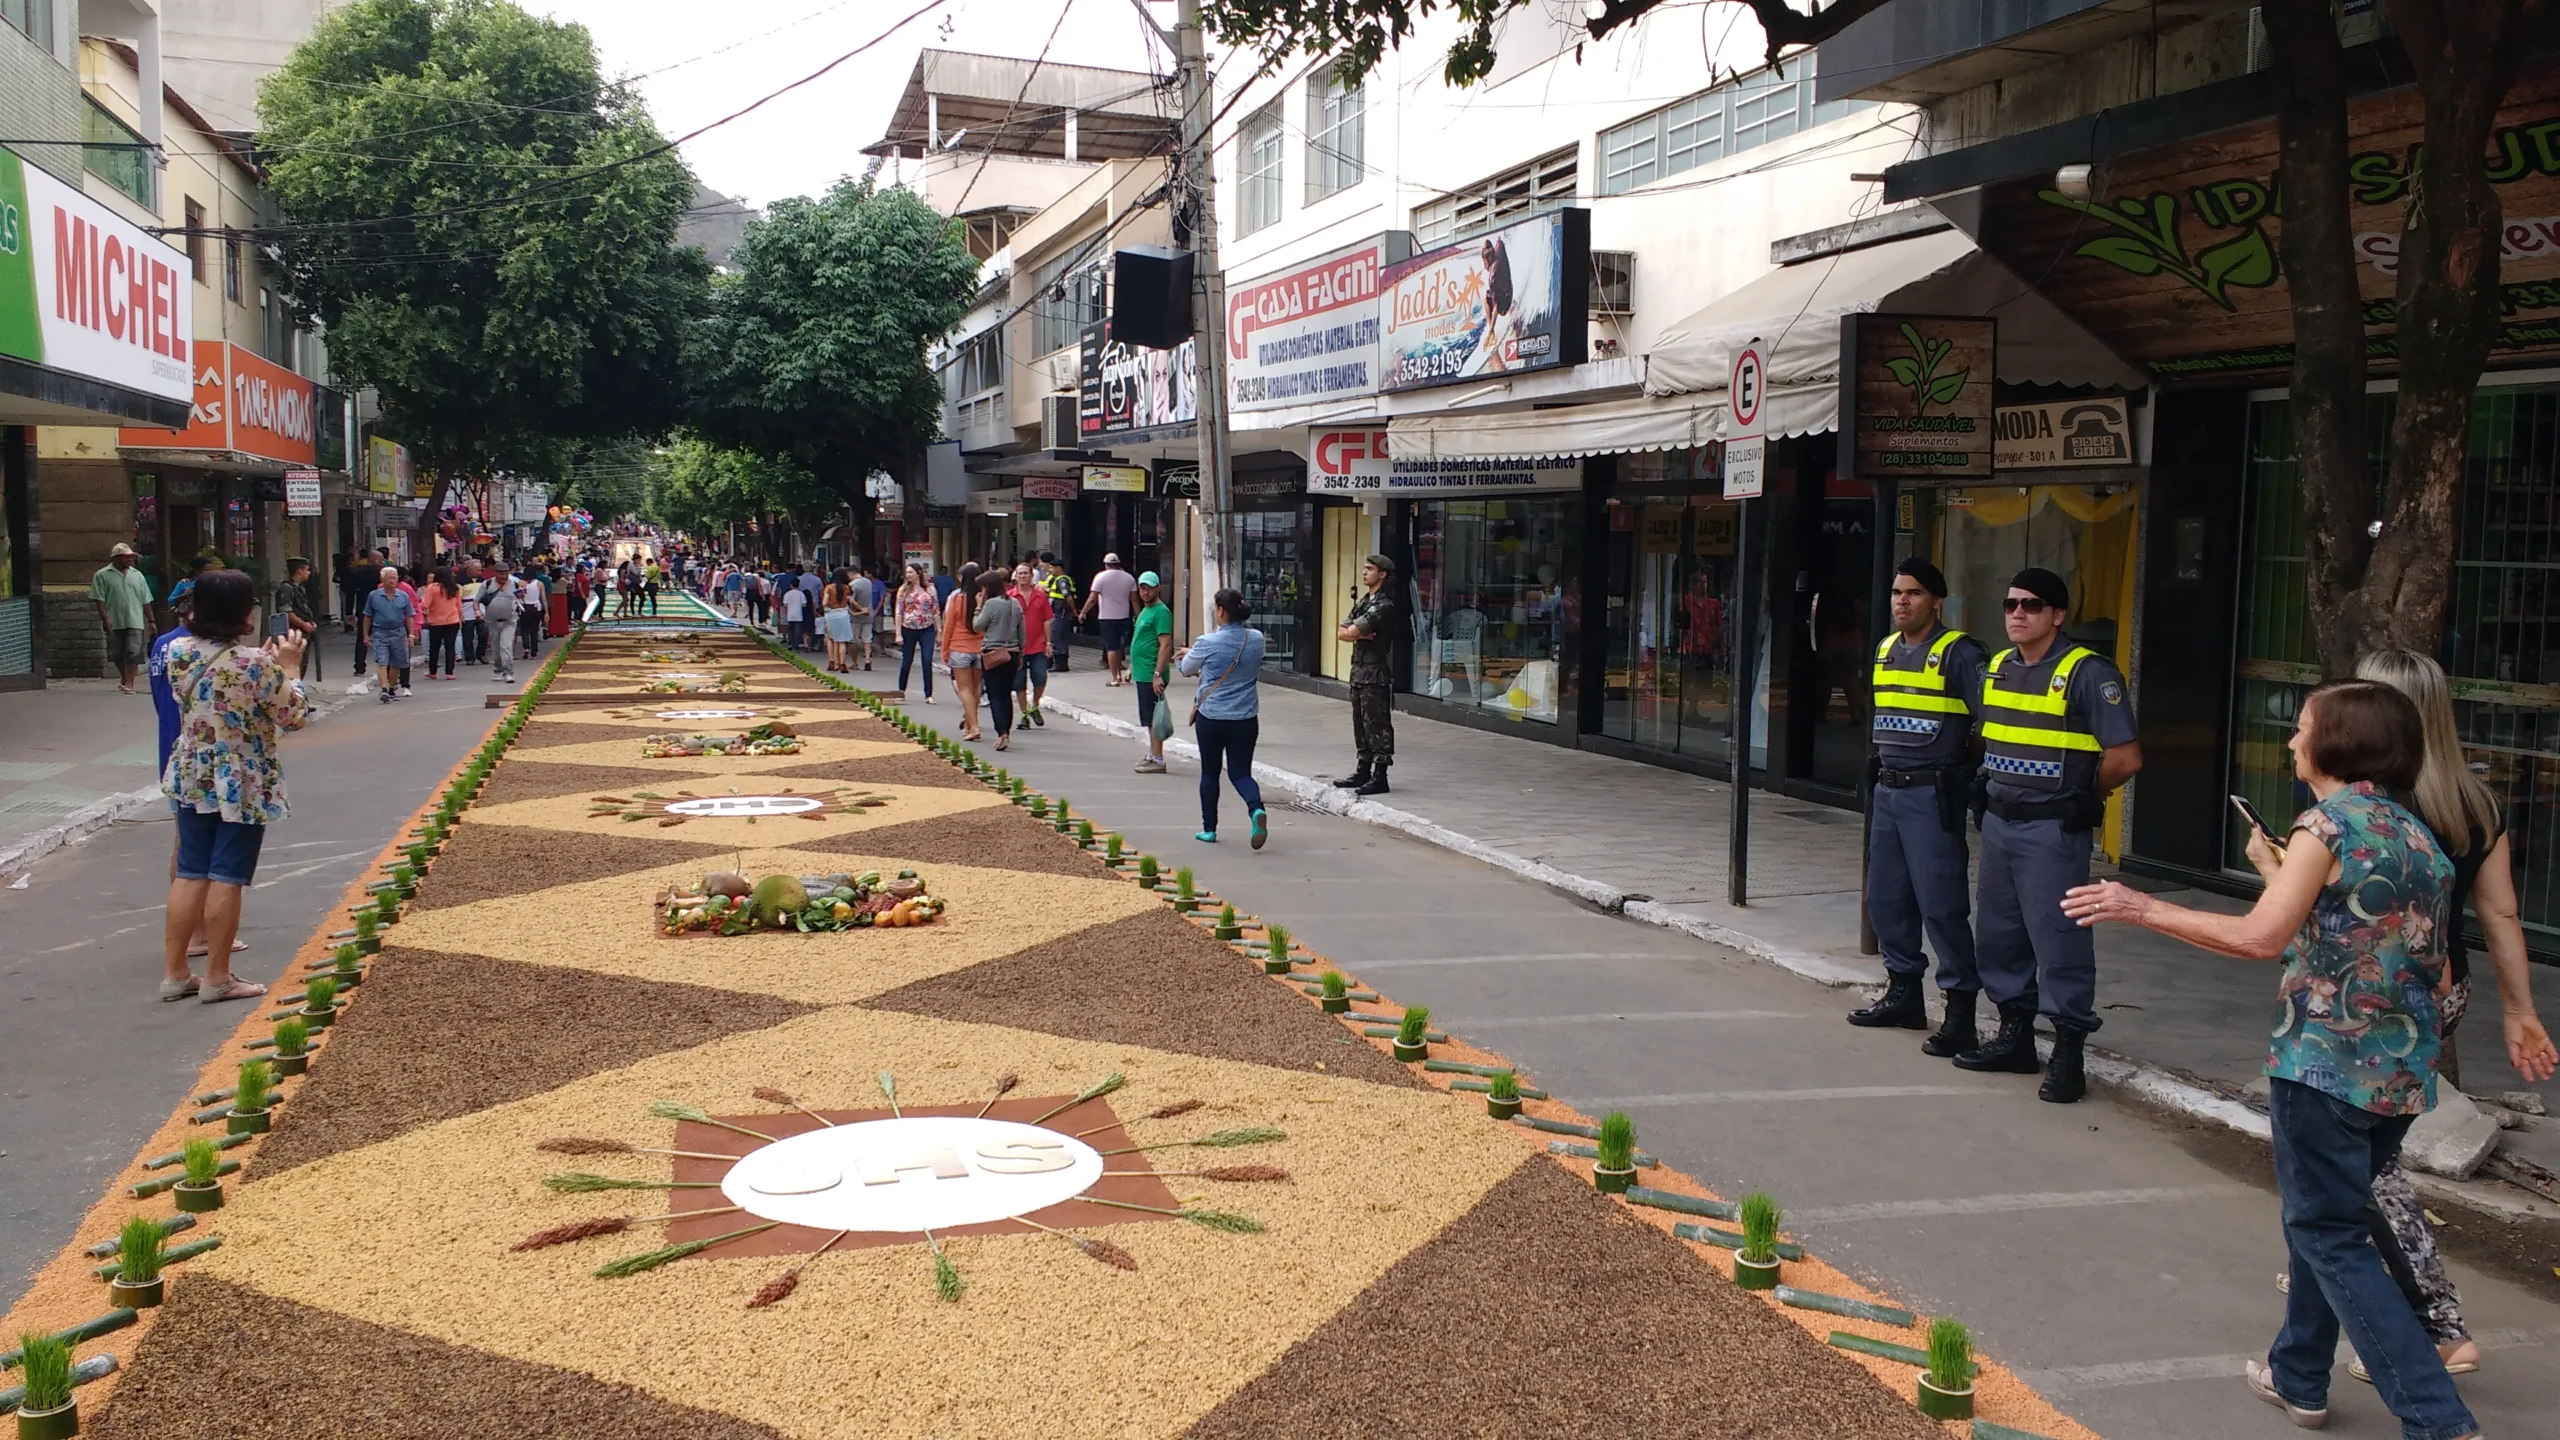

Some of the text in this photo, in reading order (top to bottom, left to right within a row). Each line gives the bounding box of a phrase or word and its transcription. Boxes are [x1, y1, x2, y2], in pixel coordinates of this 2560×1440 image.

[54, 204, 187, 363] MICHEL
[1257, 281, 1303, 324] CASA
[1387, 267, 1458, 335] Jadd's
[1424, 320, 1456, 340] modas
[1259, 337, 1288, 368] UTILIDADES
[1289, 325, 1323, 362] DOMÉSTICAS
[1325, 323, 1354, 354] MATERIAL
[1400, 349, 1464, 383] 3542-2193
[2147, 358, 2219, 372] Produtos
[1236, 376, 1266, 404] 3542-2349
[1267, 371, 1298, 400] HIDRAULICO
[1299, 368, 1318, 395] TINTAS
[1742, 365, 1754, 409] E
[1873, 418, 1904, 432] VIDA
[1889, 434, 1960, 448] Suplementos
[2072, 436, 2115, 447] 3542
[1316, 433, 1366, 474] CF
[1727, 447, 1763, 464] EXCLUSIVO
[1880, 453, 1969, 468] (28) 3310-4988
[2048, 450, 2056, 461] A
[1393, 462, 1438, 473] UTILIDADES
[1493, 460, 1533, 472] MATERIAL
[1388, 476, 1437, 488] HIDRAULICO
[1439, 476, 1467, 487] TINTAS
[1469, 476, 1474, 486] E
[1475, 473, 1537, 486] FERRAMENTAS.
[1732, 470, 1755, 485] MOTOS
[1023, 479, 1077, 492] PANIFICADORA
[1032, 486, 1069, 498] VENEZA
